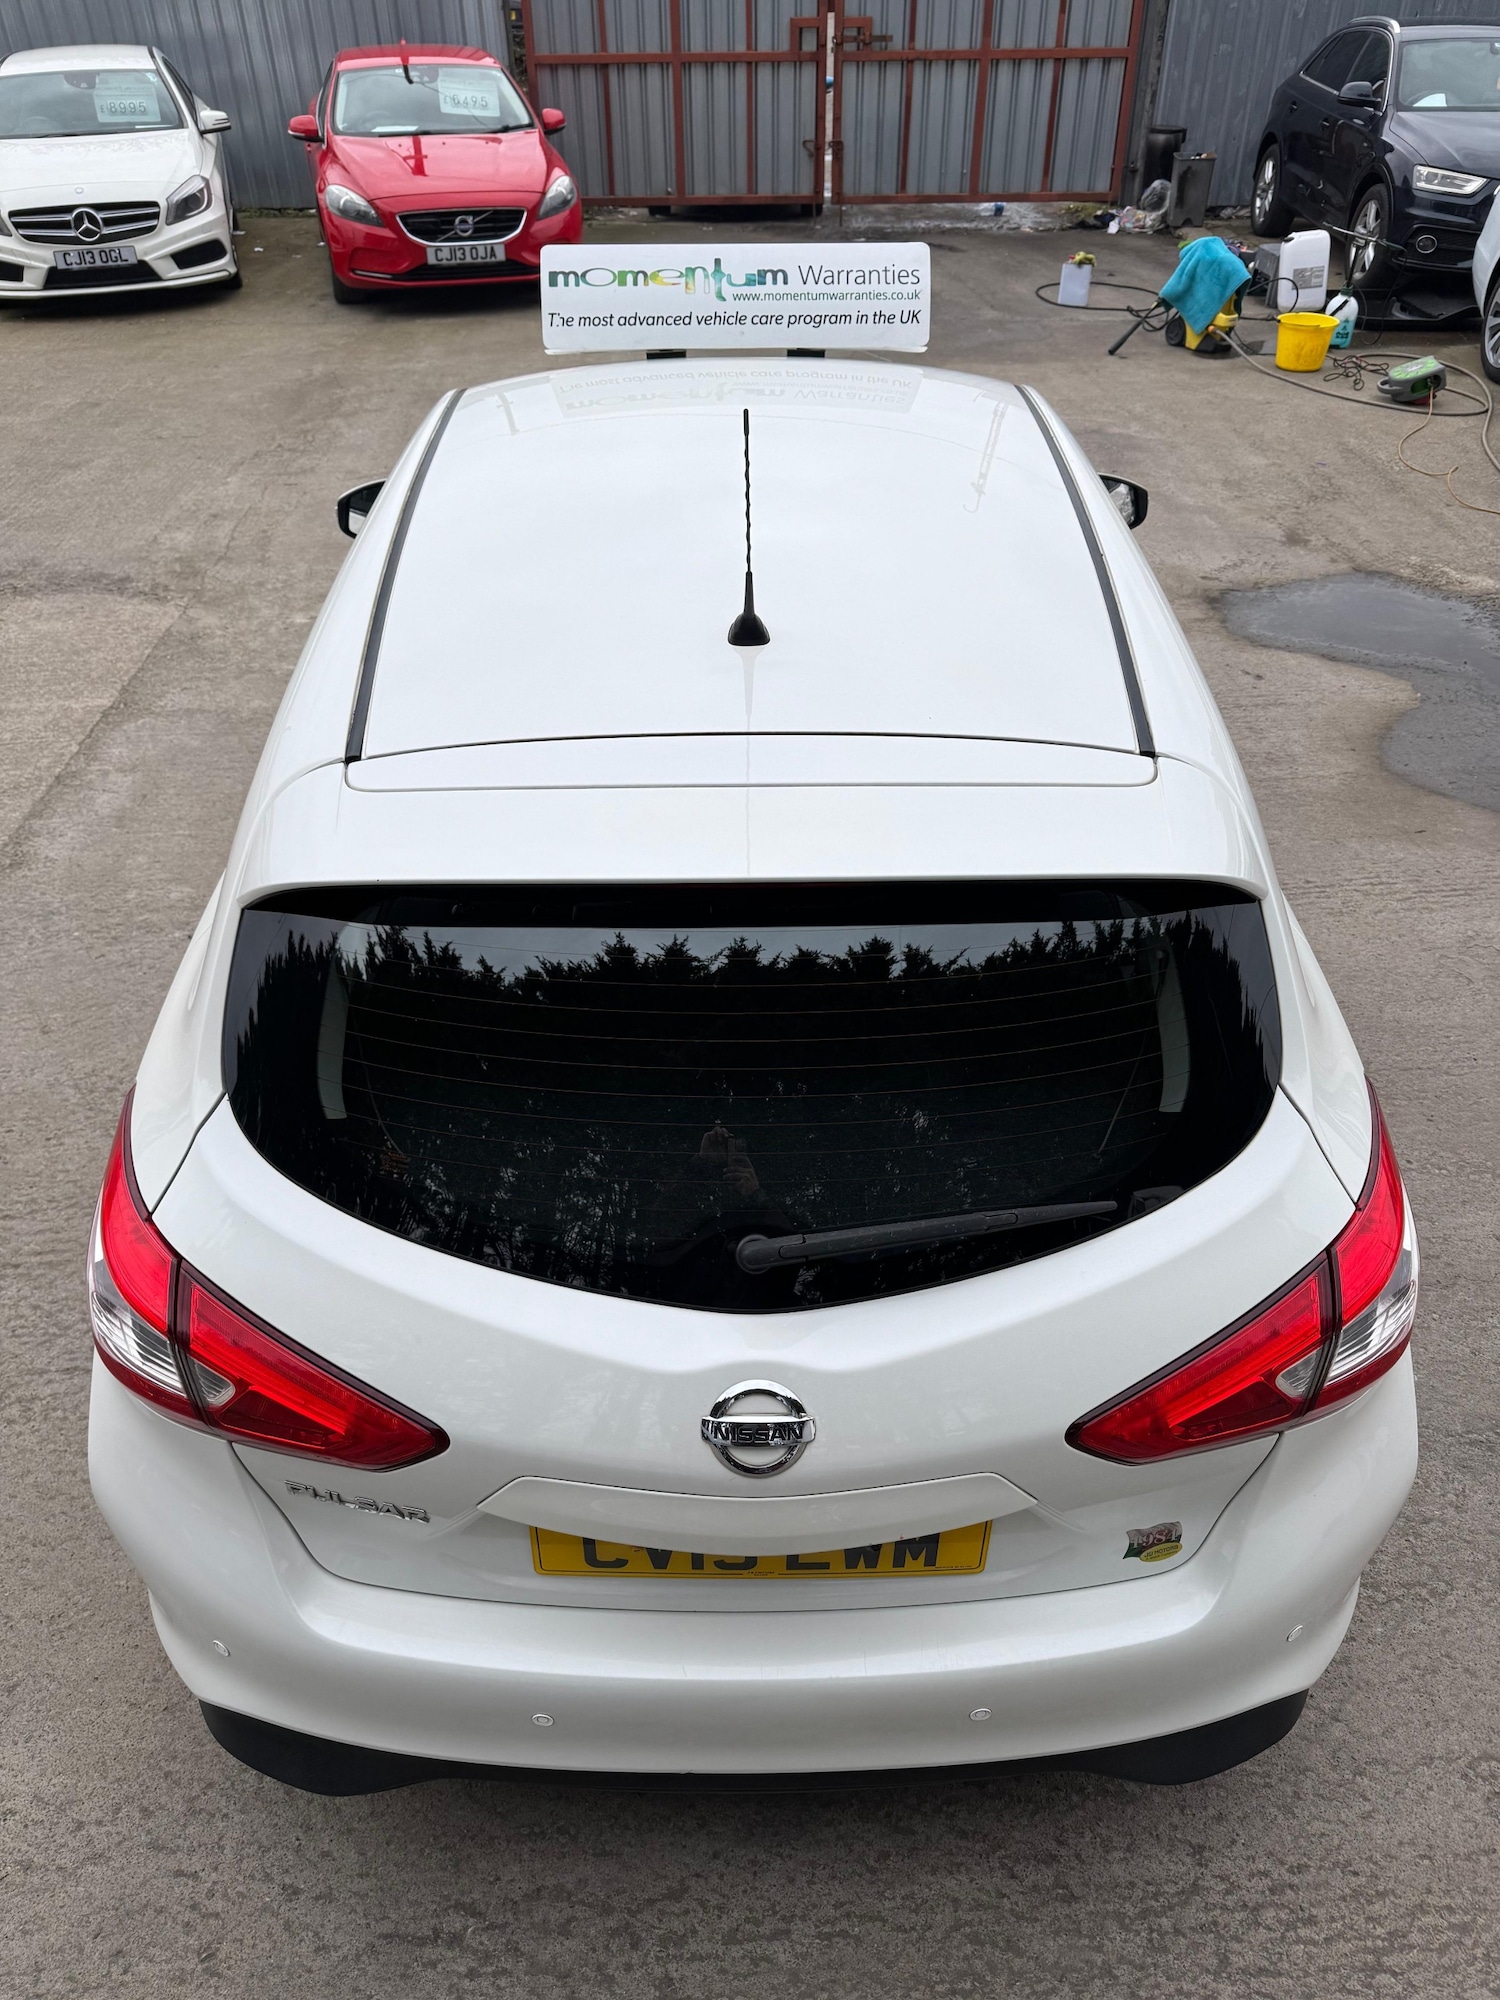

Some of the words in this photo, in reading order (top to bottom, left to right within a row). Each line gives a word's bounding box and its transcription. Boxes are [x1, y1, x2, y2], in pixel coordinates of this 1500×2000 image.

[63, 250, 96, 266] CJ13
[99, 248, 129, 264] OGL
[434, 246, 466, 262] CJ13
[470, 246, 497, 260] OJA
[548, 258, 789, 302] momentum
[798, 264, 921, 286] Warranties
[732, 290, 921, 301] www.momentumwarranties.co.uk
[578, 313, 614, 327] most
[617, 312, 692, 327] advanced
[696, 311, 747, 326] vehicle
[751, 313, 784, 326] care
[787, 312, 852, 328] program
[856, 310, 869, 325] in
[872, 311, 896, 325] the
[900, 310, 921, 324] UK
[713, 1421, 803, 1443] NISSAN
[284, 1480, 430, 1523] PULSAR
